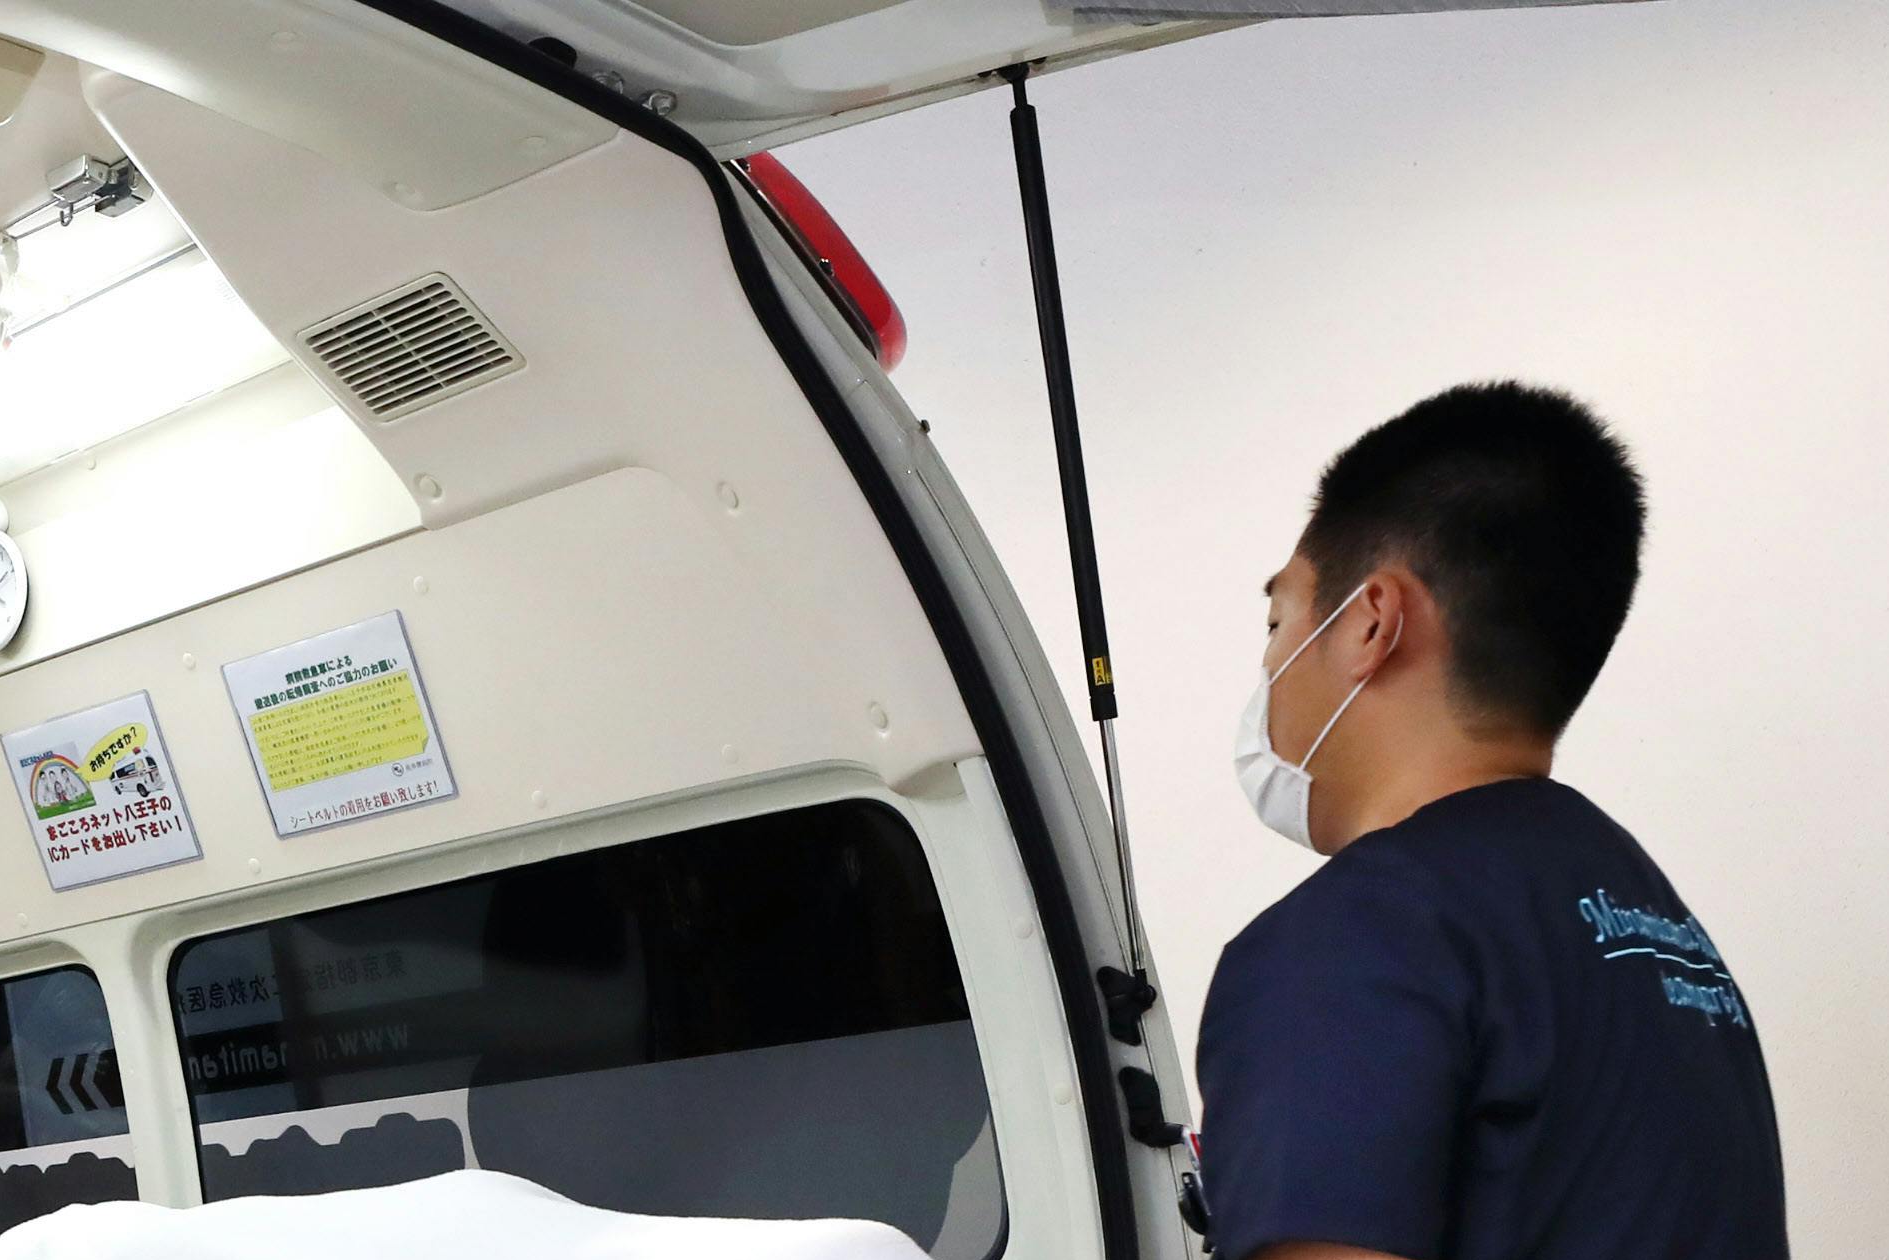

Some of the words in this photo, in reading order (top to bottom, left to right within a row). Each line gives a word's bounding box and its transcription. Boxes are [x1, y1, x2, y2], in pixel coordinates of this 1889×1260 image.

[89, 726, 138, 773] お持ちですか?
[46, 796, 173, 842] まごころネット八王子の
